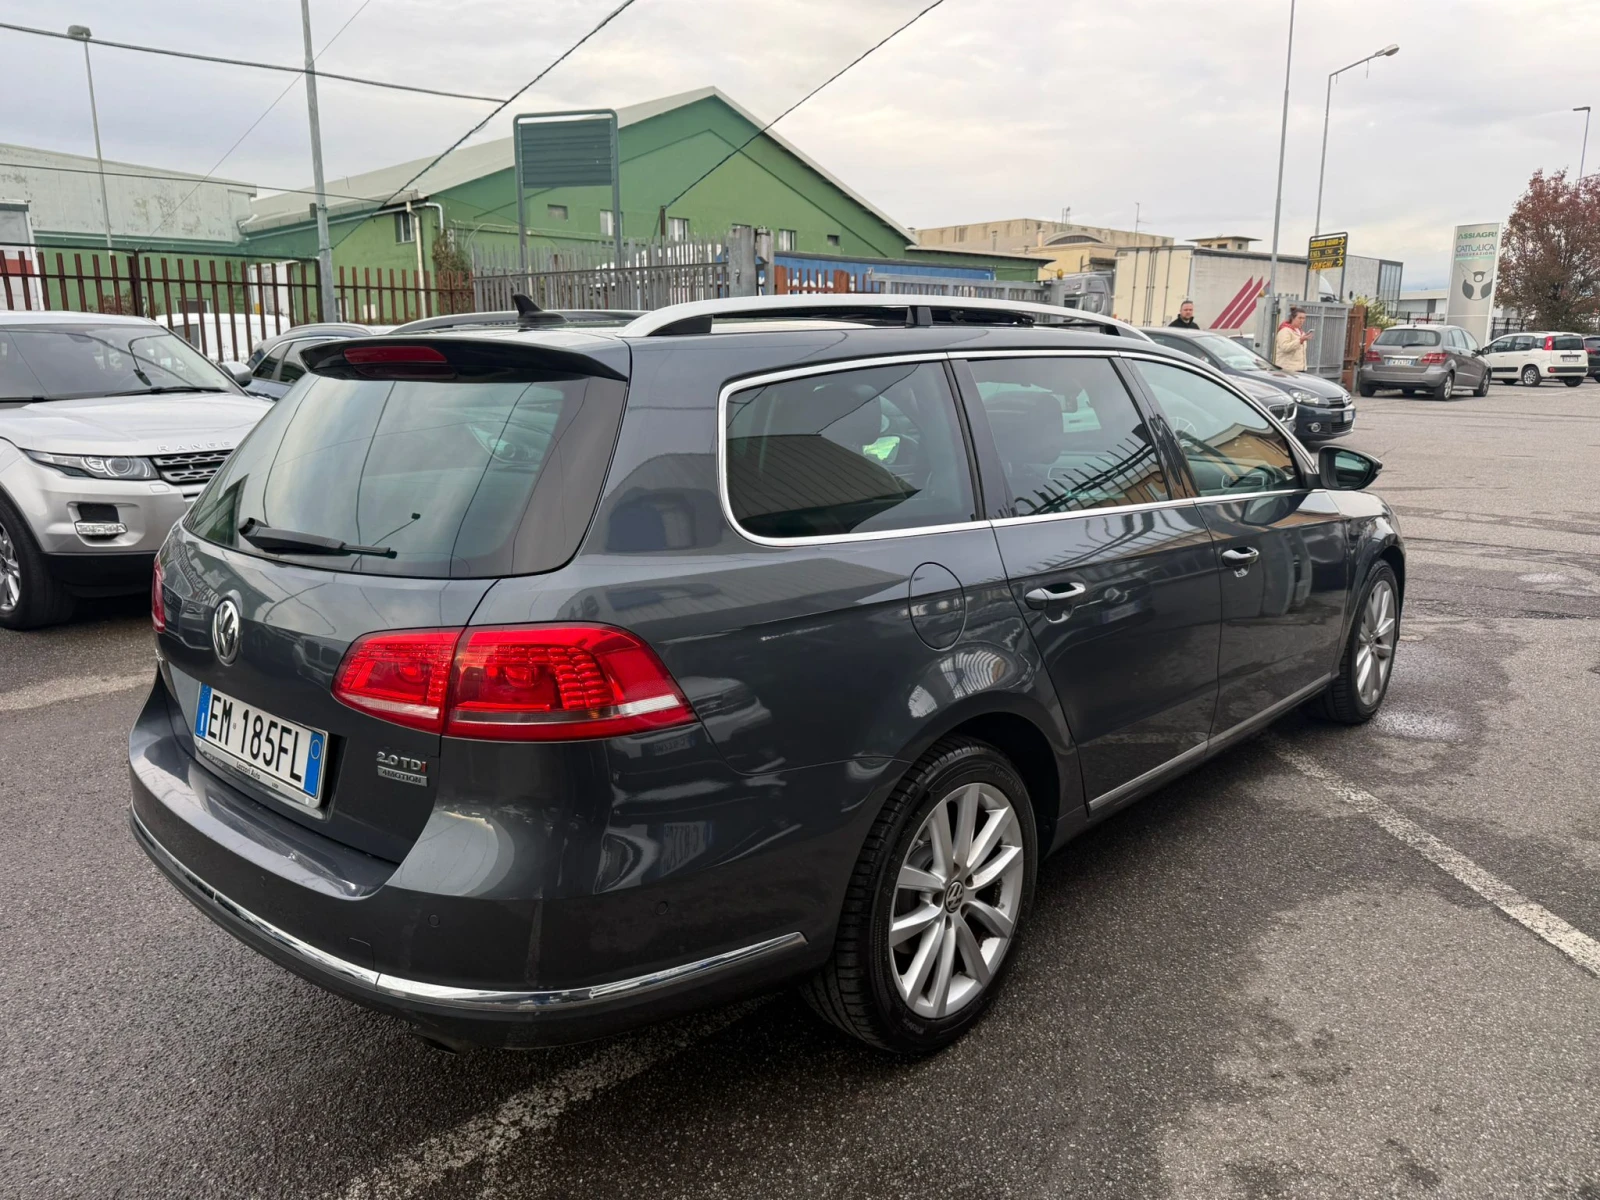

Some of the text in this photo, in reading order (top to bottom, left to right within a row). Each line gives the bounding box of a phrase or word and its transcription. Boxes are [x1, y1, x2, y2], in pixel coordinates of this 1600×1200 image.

[1455, 243, 1495, 253] CATTOLICA
[158, 441, 232, 452] RANGE
[207, 693, 302, 783] EM 185FL
[376, 751, 399, 765] 2.0
[383, 770, 421, 782] 4MOTION
